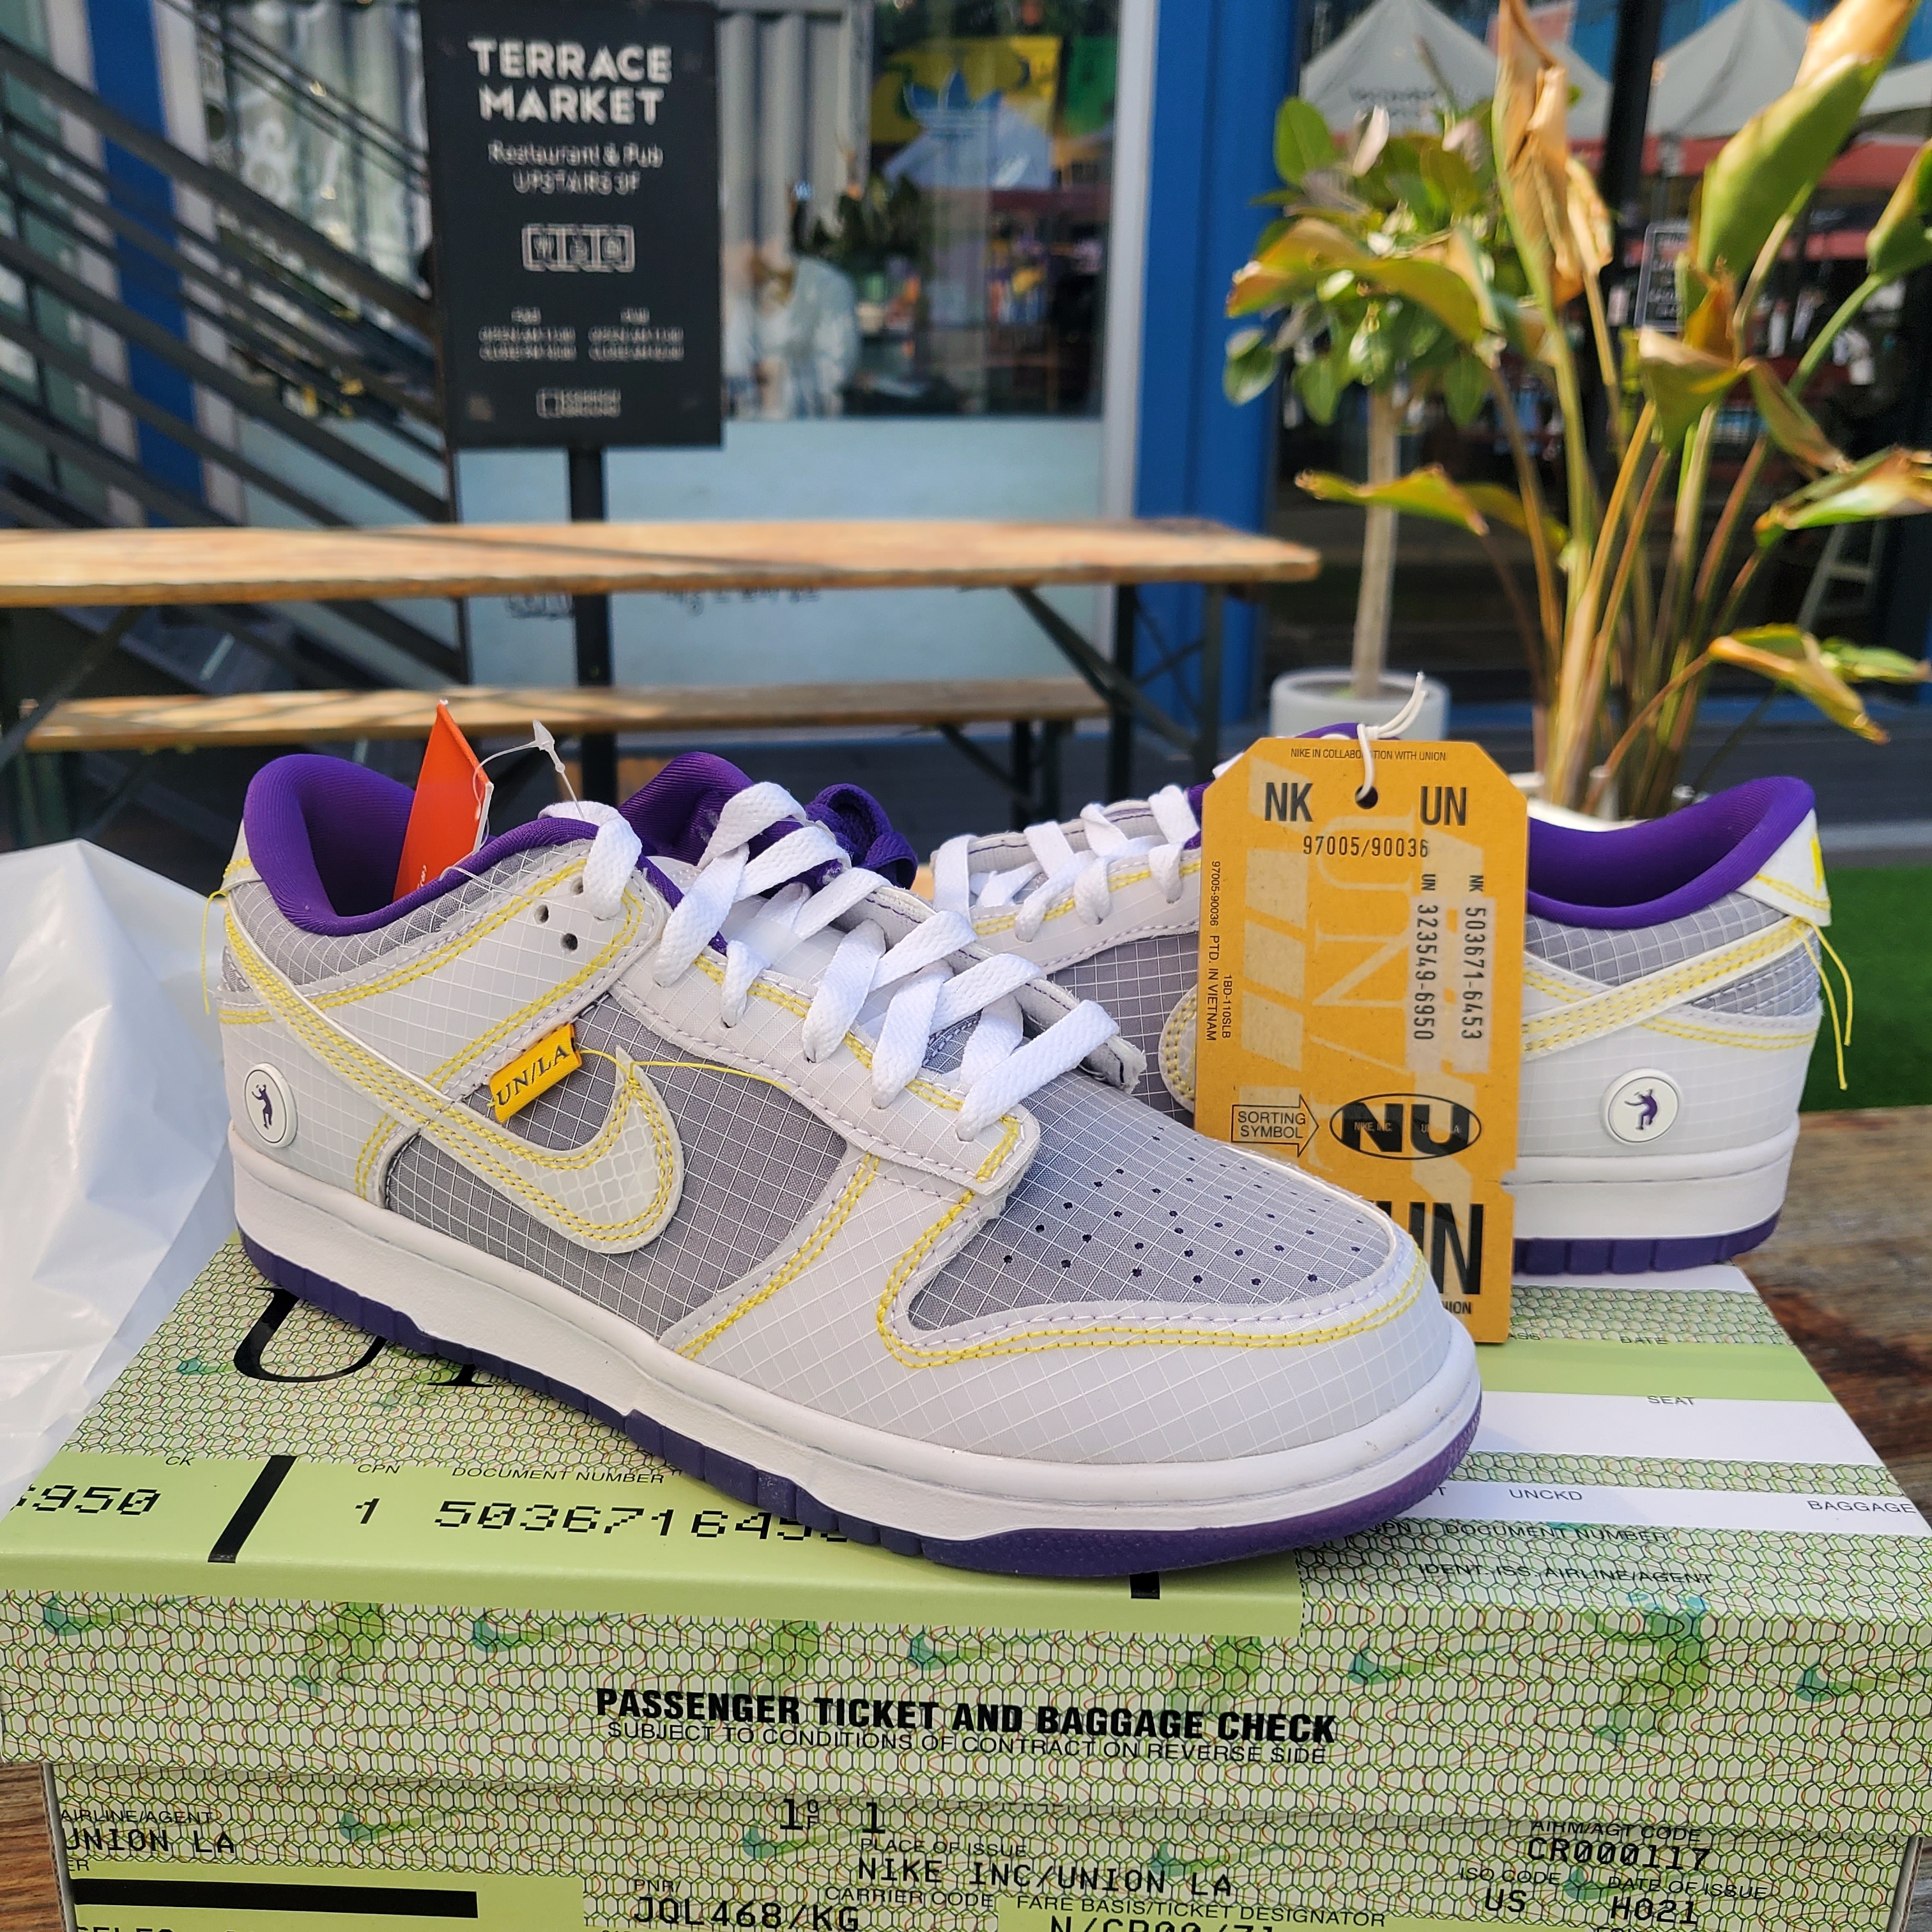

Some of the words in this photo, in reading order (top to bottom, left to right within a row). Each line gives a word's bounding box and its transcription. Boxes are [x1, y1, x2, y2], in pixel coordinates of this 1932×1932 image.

[468, 38, 673, 84] TERRACE
[479, 84, 664, 125] MARKET
[488, 139, 599, 167] Restaurant
[623, 142, 664, 168] Pub
[1291, 748, 1310, 758] NIKE
[1312, 749, 1321, 758] IN
[1322, 749, 1393, 760] COLLABOTION
[1395, 750, 1416, 760] WITH
[1419, 751, 1446, 761] UNION
[1265, 782, 1314, 822] NK
[1419, 786, 1467, 826] UN
[1303, 834, 1430, 857] 97005/90036
[1209, 861, 1220, 926] 97005-90036
[1420, 873, 1436, 891] UN
[1469, 875, 1484, 893] NK
[1208, 935, 1220, 964] PTD.
[1208, 968, 1218, 981] IN
[1413, 904, 1438, 1040] 323549-6950
[1461, 907, 1487, 1039] 503671-6453
[1206, 983, 1217, 1041] VIETNAM
[1222, 974, 1232, 1039] 1BD-110SLB
[496, 1044, 570, 1106] UN/LA
[1238, 1110, 1306, 1125] SORTING
[1341, 1102, 1471, 1155] NU
[1240, 1125, 1303, 1139] SYMBOL
[1620, 1335, 1668, 1345] DATE
[1647, 1395, 1696, 1406] SEAT
[357, 1464, 401, 1474] CPN
[451, 1468, 570, 1481] DOCUMENT
[575, 1471, 665, 1483] NUMBER
[355, 1497, 380, 1524] 1
[1508, 1488, 1583, 1501] UNCKD
[1807, 1500, 1917, 1514] BAGGAGE
[1445, 1523, 1570, 1538] DOCUMENT
[1574, 1528, 1670, 1543] NUMBER
[1545, 1567, 1714, 1585] AIRLINE/AGENT
[596, 1687, 799, 1724] PASSENGER
[813, 1698, 940, 1731] TICKET
[952, 1703, 1022, 1733] AND
[1037, 1706, 1203, 1740] BAGGAGE
[1218, 1711, 1337, 1744] CHECK
[608, 1721, 716, 1743] SUBJECT
[722, 1726, 755, 1744] TO
[762, 1728, 913, 1751] CONDITIONS
[921, 1735, 954, 1752] OF
[962, 1736, 1096, 1757] CONTRACT
[1103, 1741, 1138, 1758] ON
[1150, 1743, 1261, 1763] REVERSE
[1270, 1747, 1326, 1765] SIDE
[61, 1809, 213, 1825] AIRLINE/AGENT
[193, 1830, 235, 1854] LA
[1641, 1825, 1702, 1842] CODE
[860, 1838, 926, 1854] PLACE
[932, 1841, 960, 1854] OF
[968, 1843, 1027, 1858] ISSUE
[1528, 1837, 1712, 1872] CR000117
[857, 1857, 943, 1884] NIKE
[969, 1862, 1165, 1894] INC/UNION
[1192, 1871, 1232, 1897] LA
[1460, 1866, 1495, 1881] ISO
[1501, 1869, 1562, 1885] CODE
[1607, 1876, 1662, 1892] DATE
[1668, 1880, 1698, 1894] OF
[1704, 1882, 1768, 1899] ISSUE
[633, 1879, 681, 1893] PNR/
[824, 1887, 924, 1905] CARRIER
[931, 1891, 995, 1908] CODE
[1016, 1895, 1073, 1912] FARE
[1081, 1899, 1236, 1919] BASIS/TICKET
[1239, 1905, 1385, 1928] DESIGNATOR
[633, 1896, 859, 1932] JQL468/KG
[1484, 1888, 1526, 1913] US
